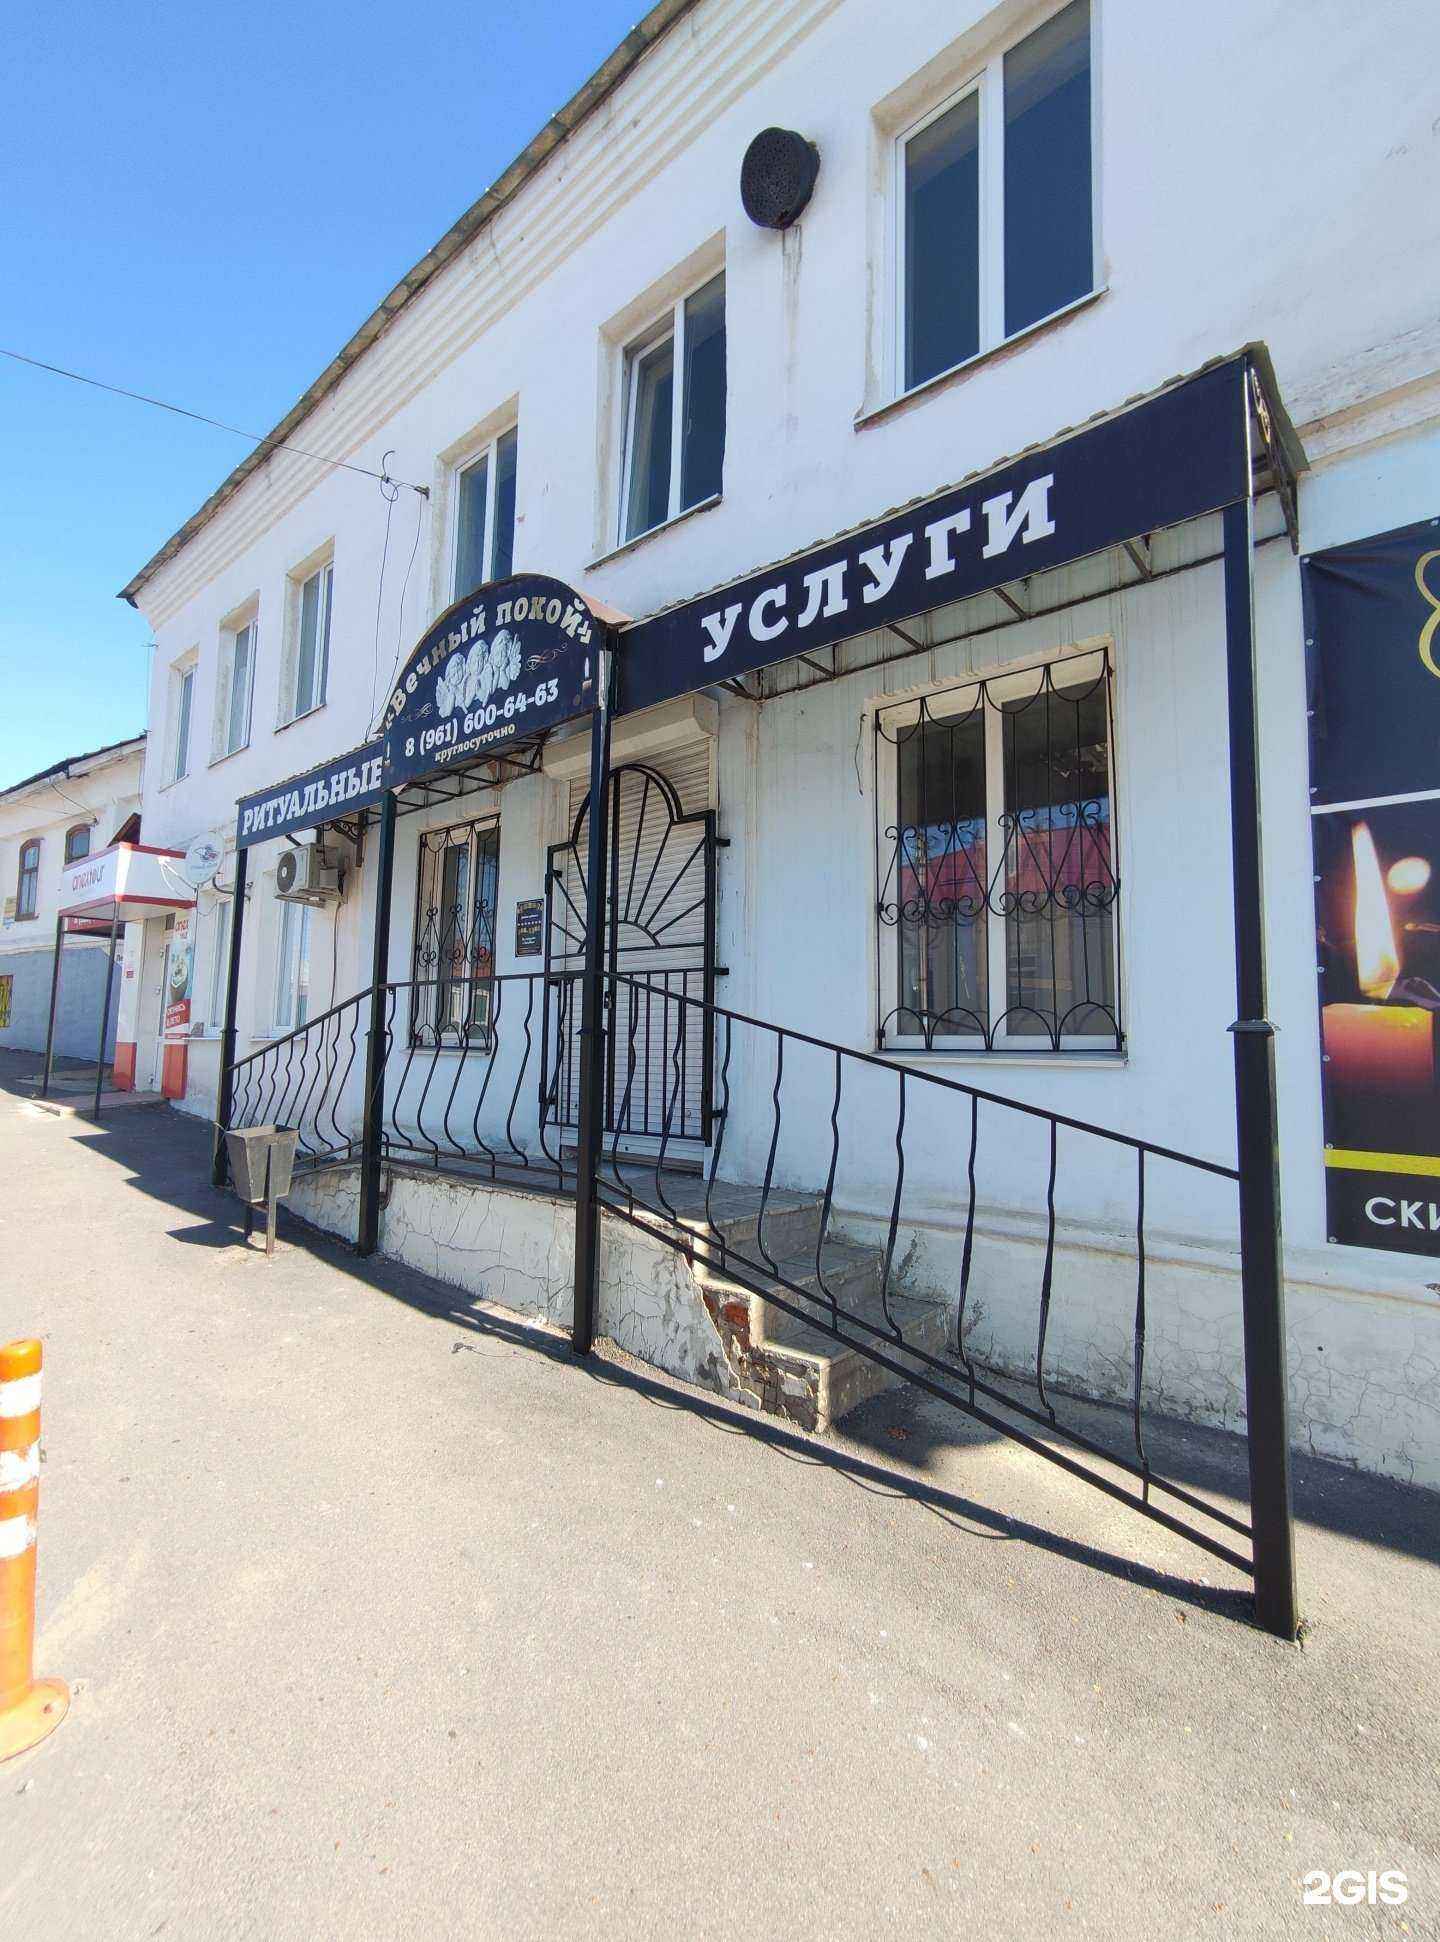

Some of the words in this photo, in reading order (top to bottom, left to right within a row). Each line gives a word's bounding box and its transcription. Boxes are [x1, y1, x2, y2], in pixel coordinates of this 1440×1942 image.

[701, 473, 1056, 663] УСЛУГИ
[404, 737, 415, 757] 8
[419, 719, 458, 755] (961)
[463, 678, 559, 735] 600-64-63
[434, 723, 516, 763] круглосуточно
[242, 756, 384, 836] РИТУАЛЬНЫЕ
